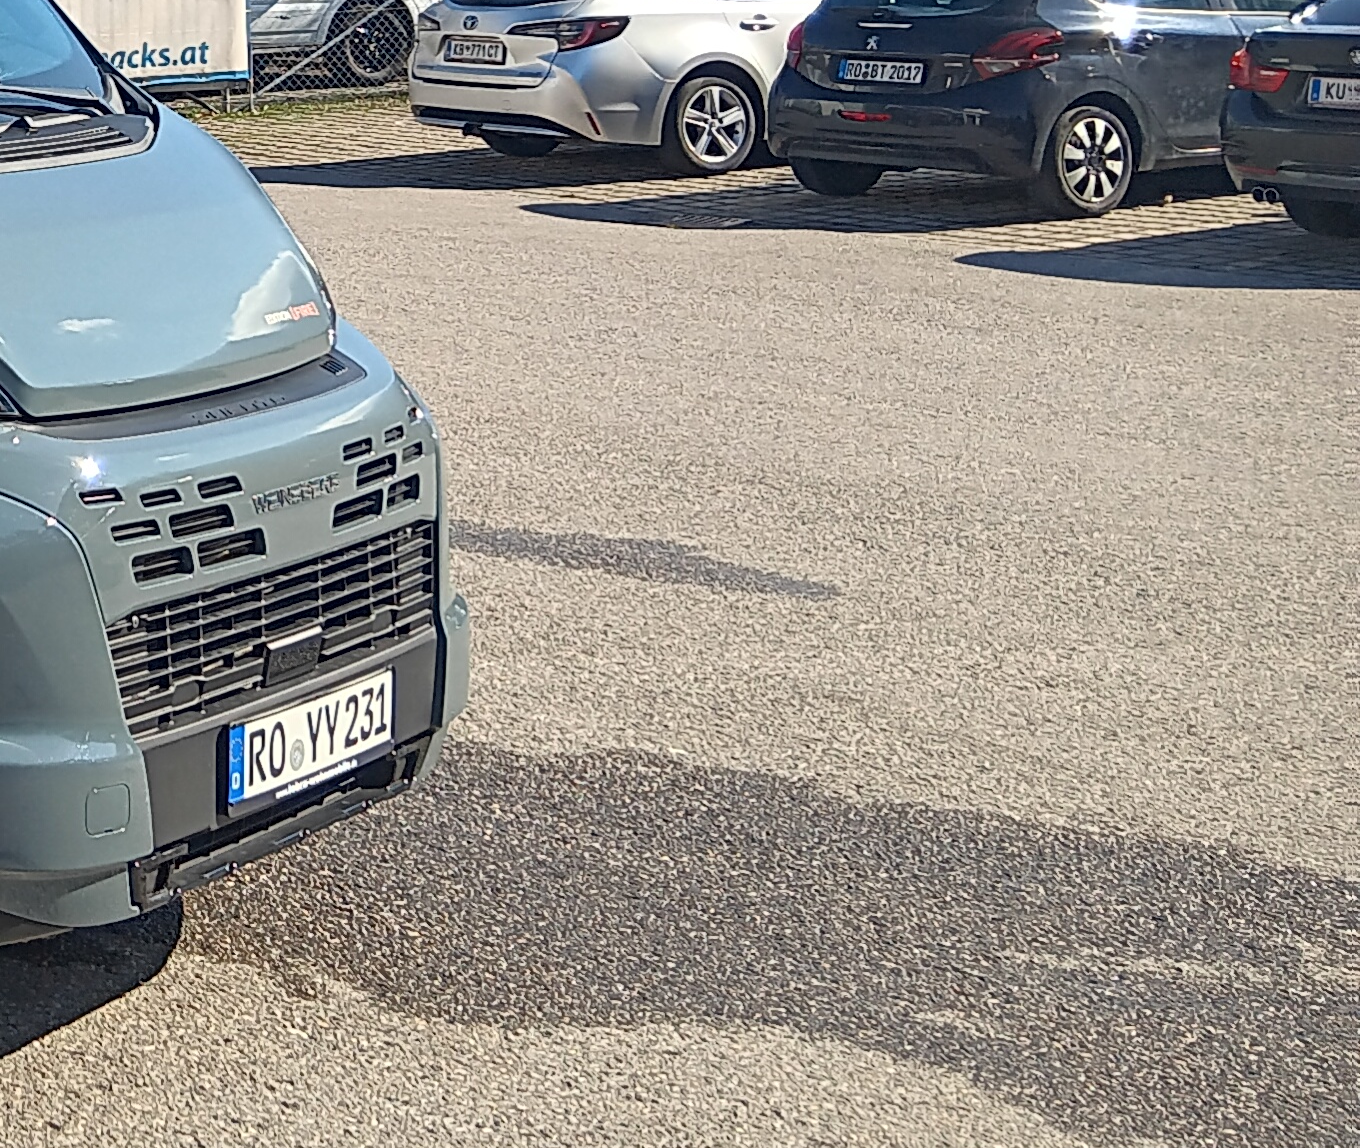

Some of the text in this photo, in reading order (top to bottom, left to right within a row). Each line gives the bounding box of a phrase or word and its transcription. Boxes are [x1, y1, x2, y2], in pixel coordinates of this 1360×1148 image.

[846, 63, 922, 81] RO BT 2017
[1325, 82, 1347, 100] KU
[248, 682, 388, 787] RO YY 231
